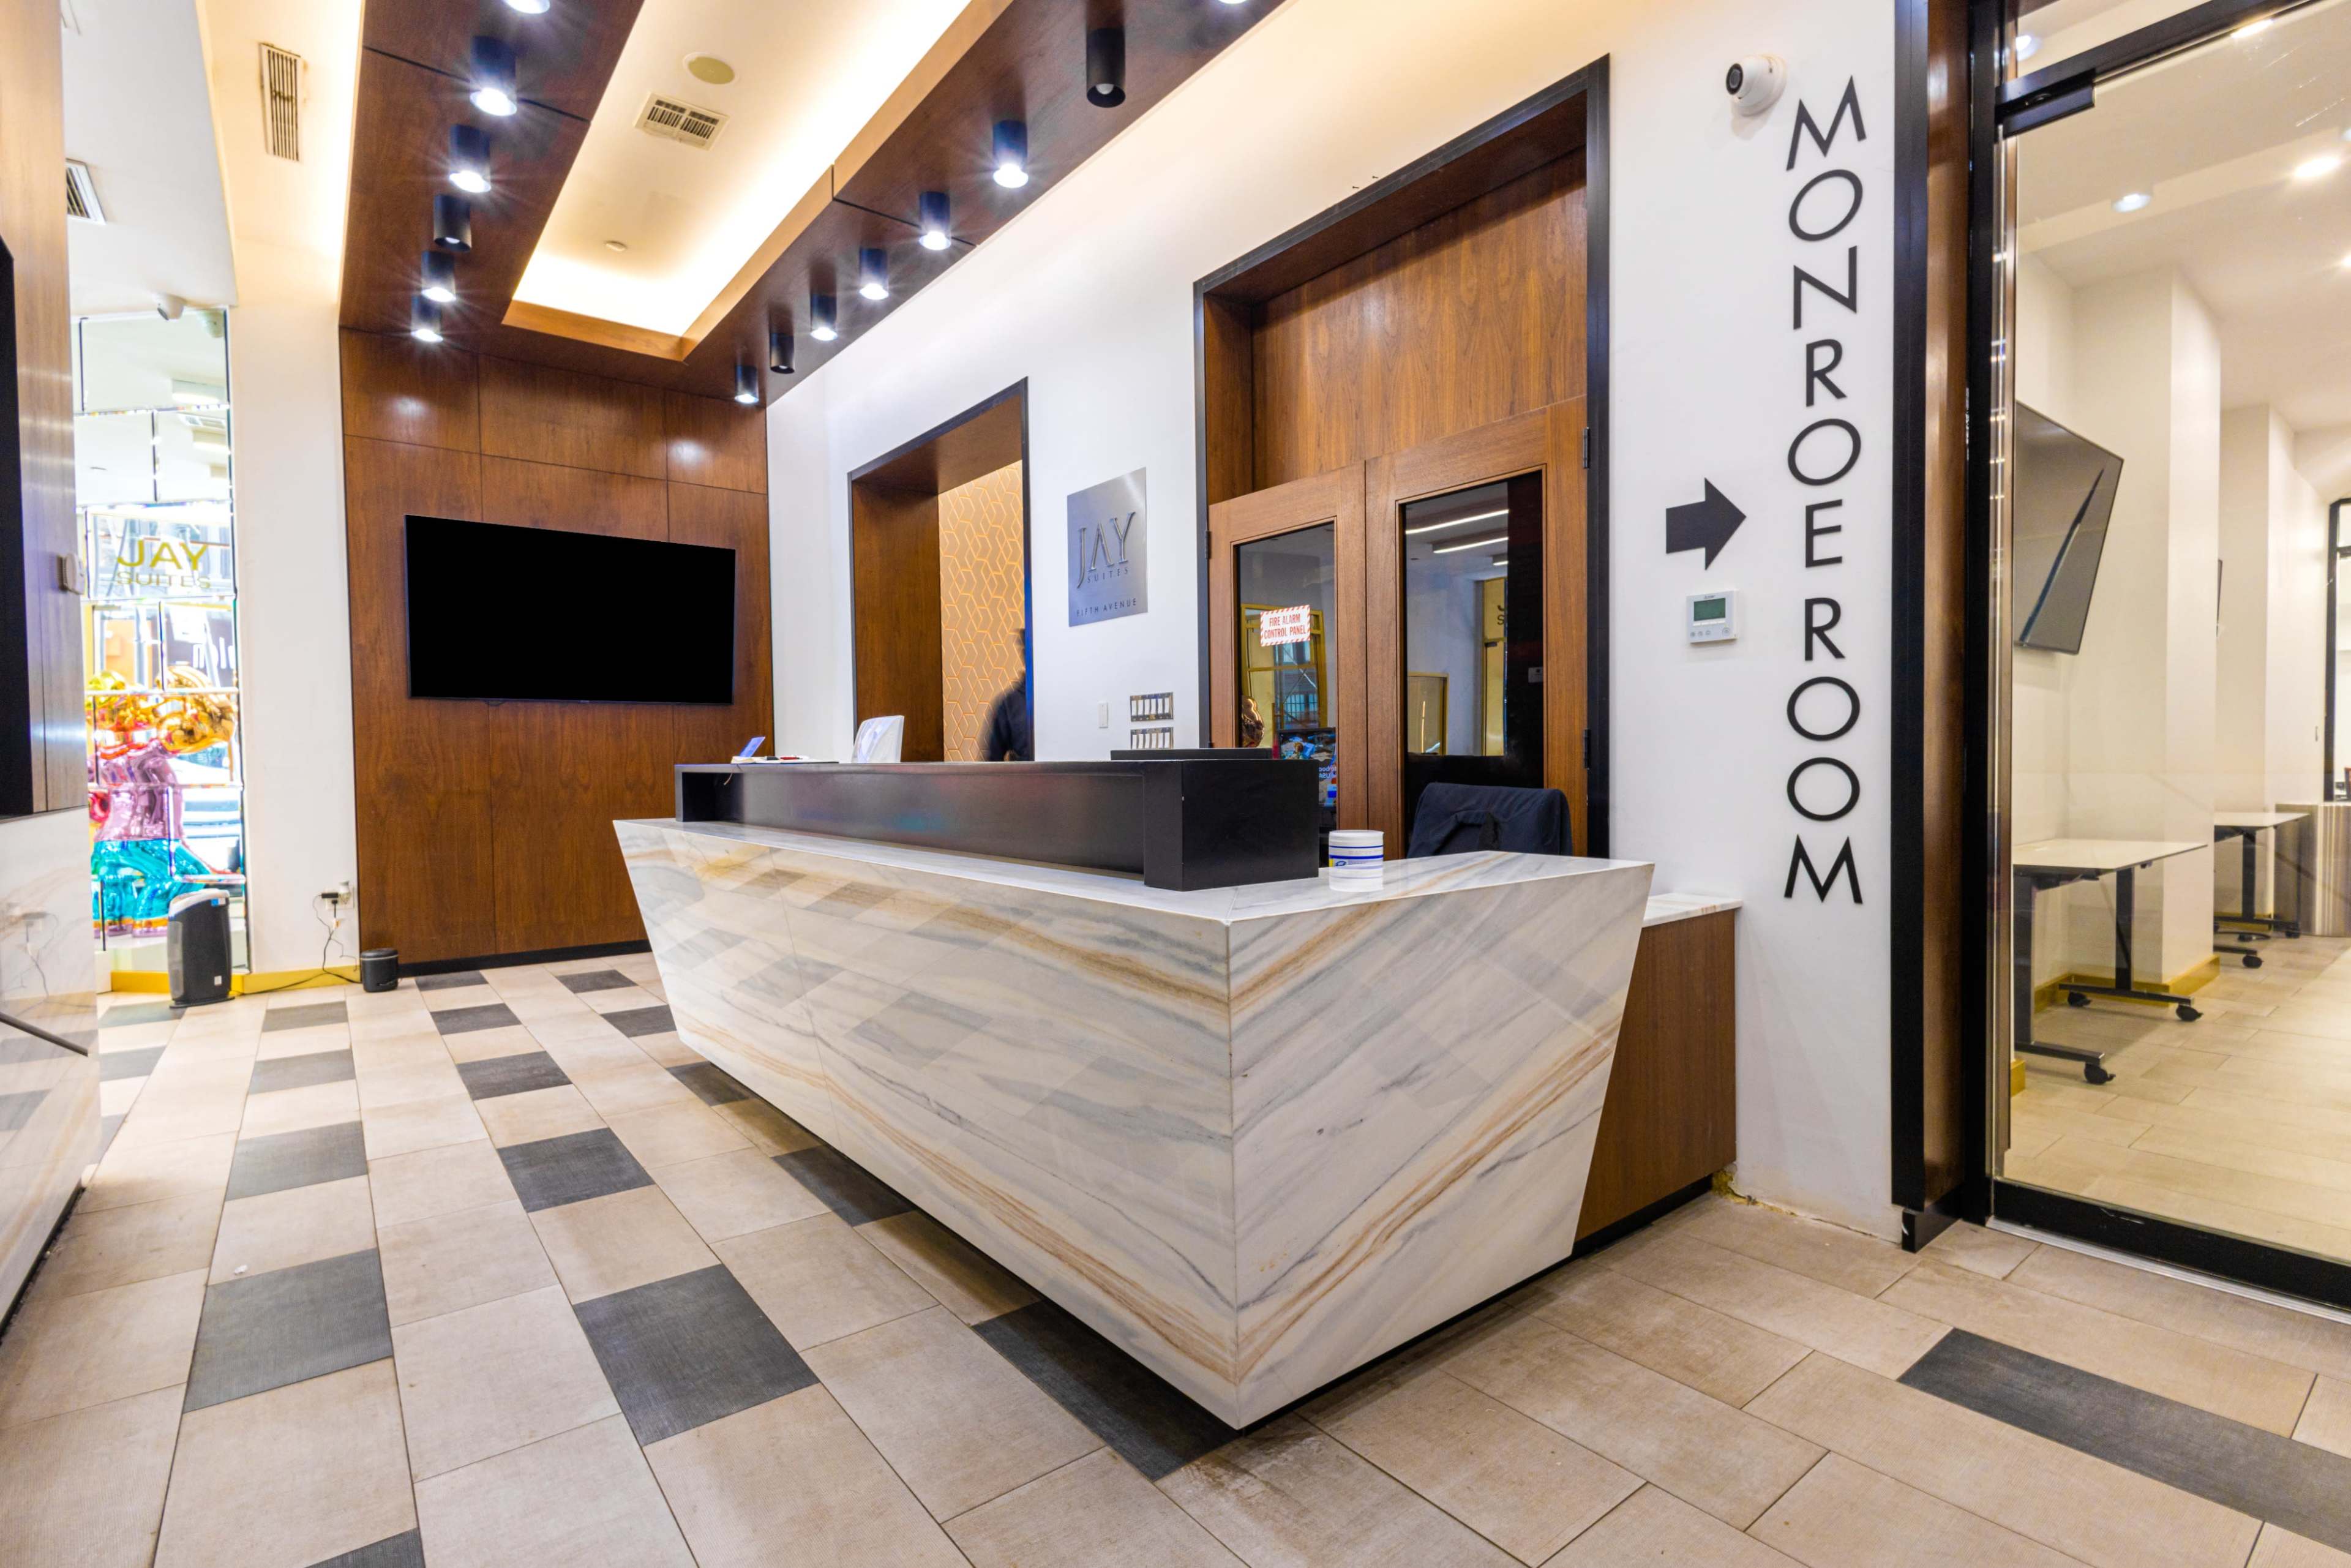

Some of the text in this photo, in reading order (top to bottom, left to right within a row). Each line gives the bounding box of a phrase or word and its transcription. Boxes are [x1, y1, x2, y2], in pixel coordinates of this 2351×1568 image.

[1784, 75, 1867, 904] MONROE ROOM
[117, 539, 208, 570] JAY
[1076, 511, 1136, 588] JAY
[117, 571, 211, 588] SUITES
[1087, 567, 1128, 583] SUITES
[1076, 598, 1137, 617] FIFTH AVENUE
[1269, 613, 1300, 627] FIRE ALARM
[1264, 625, 1305, 639] CONTROL PANEL
